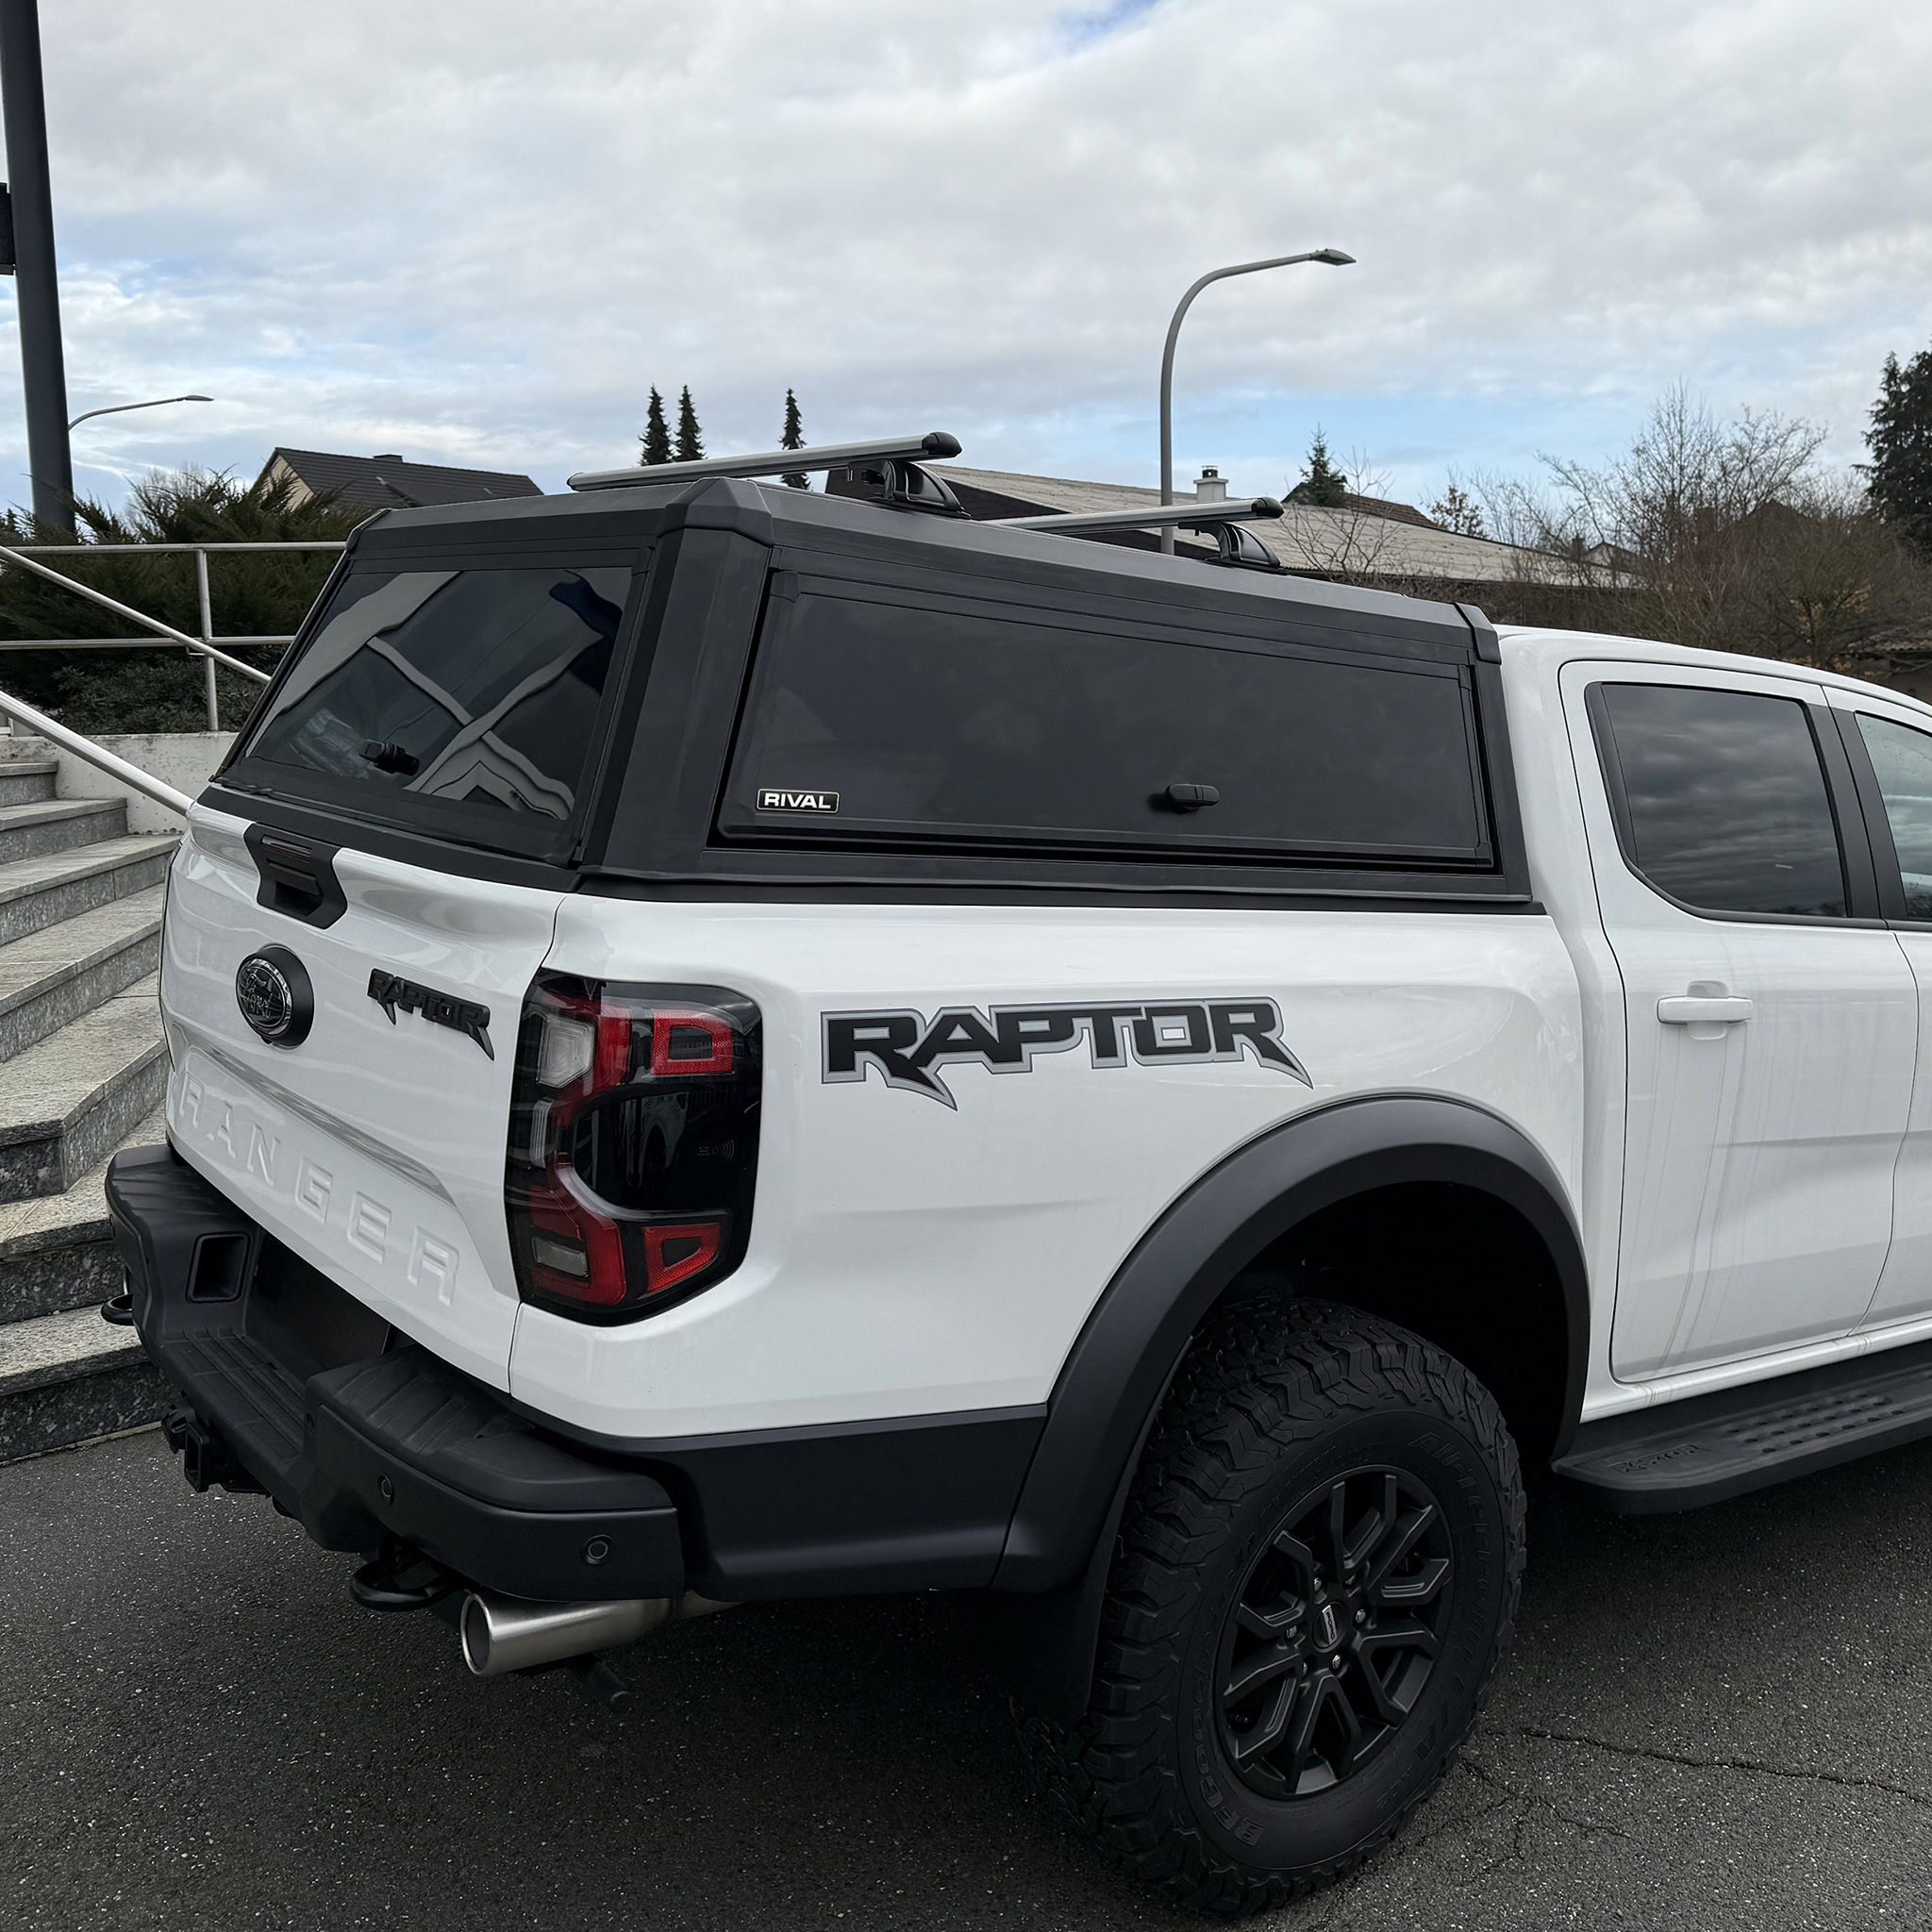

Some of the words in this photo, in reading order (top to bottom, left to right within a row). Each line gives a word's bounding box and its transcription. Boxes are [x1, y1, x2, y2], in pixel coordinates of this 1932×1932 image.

[764, 792, 831, 809] RIVAL
[367, 968, 494, 1061] RAPTOR
[821, 996, 1314, 1111] RAPTOR
[179, 1062, 459, 1307] RANGER
